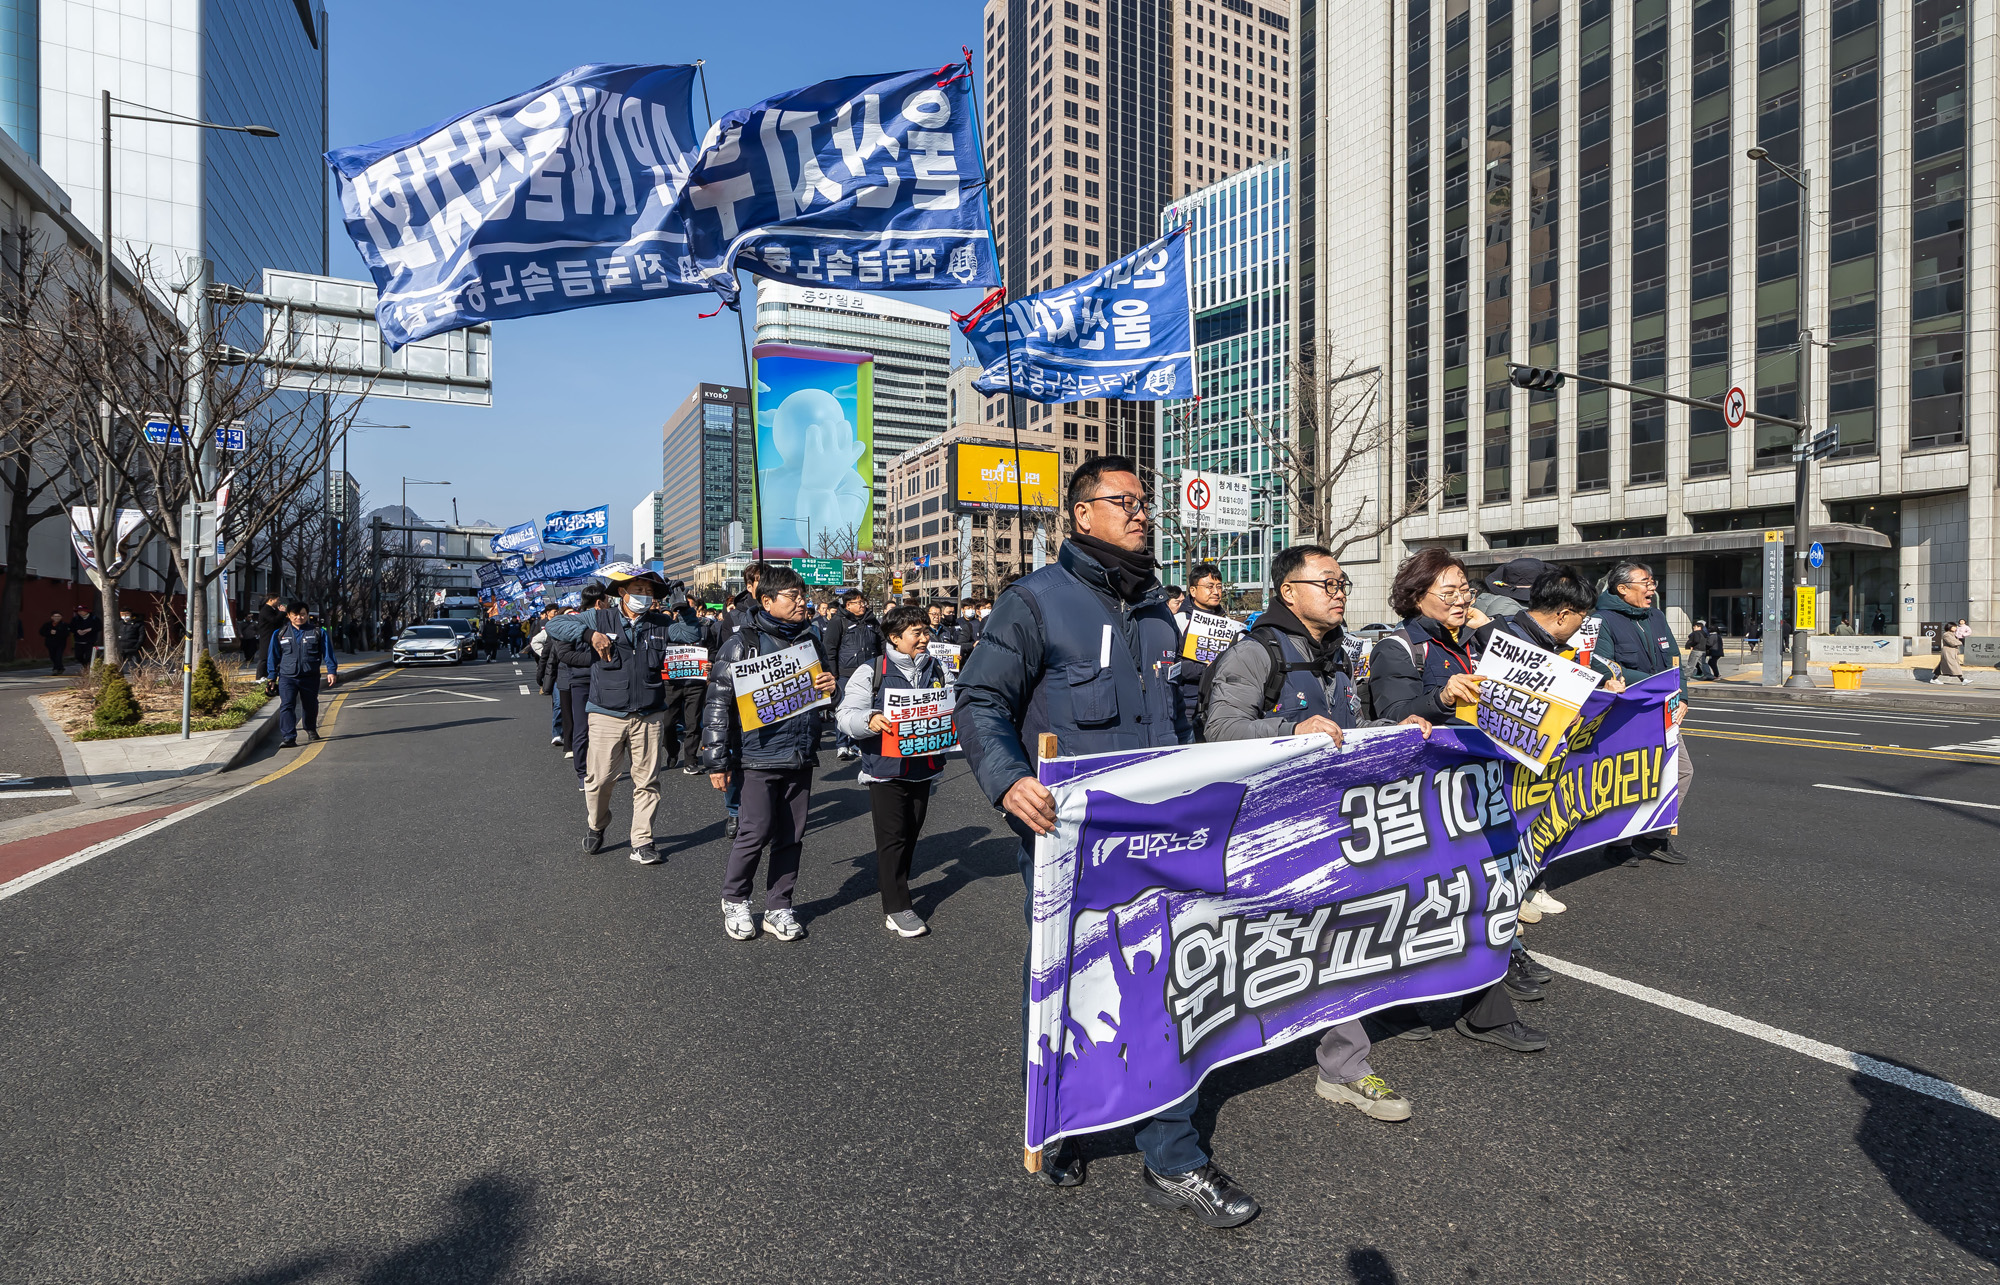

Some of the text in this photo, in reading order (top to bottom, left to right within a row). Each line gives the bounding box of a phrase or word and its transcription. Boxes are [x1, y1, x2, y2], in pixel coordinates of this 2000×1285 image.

[802, 290, 865, 310] 동아일보
[704, 391, 728, 400] KYOBO
[981, 468, 1004, 483] 먼저
[1218, 480, 1248, 492] 청계천로
[1193, 613, 1229, 628] 진짜사장
[1197, 636, 1231, 652] 원청교
[1490, 636, 1548, 670] 진짜사장
[667, 660, 700, 671] 투쟁으로
[668, 669, 704, 679] 쟁취하자!
[735, 654, 783, 678] 진짜사장
[762, 658, 802, 684] 나와라!
[752, 672, 812, 708] 원청교섭
[1503, 667, 1556, 693] 나와라!
[888, 690, 948, 708] 모든 노동자의
[1479, 679, 1550, 727] 원청교섭
[891, 704, 938, 721] 노동기본권
[898, 714, 953, 738] 투쟁으로
[1477, 702, 1550, 759] 쟁취하자!
[898, 729, 958, 756] 쟁취하자!
[1577, 747, 1663, 821] 나와라!
[1341, 774, 1429, 864] 3월
[1433, 759, 1512, 838] 10일
[1127, 827, 1209, 859] 민주노총
[1173, 869, 1472, 1056] 원청교섭
